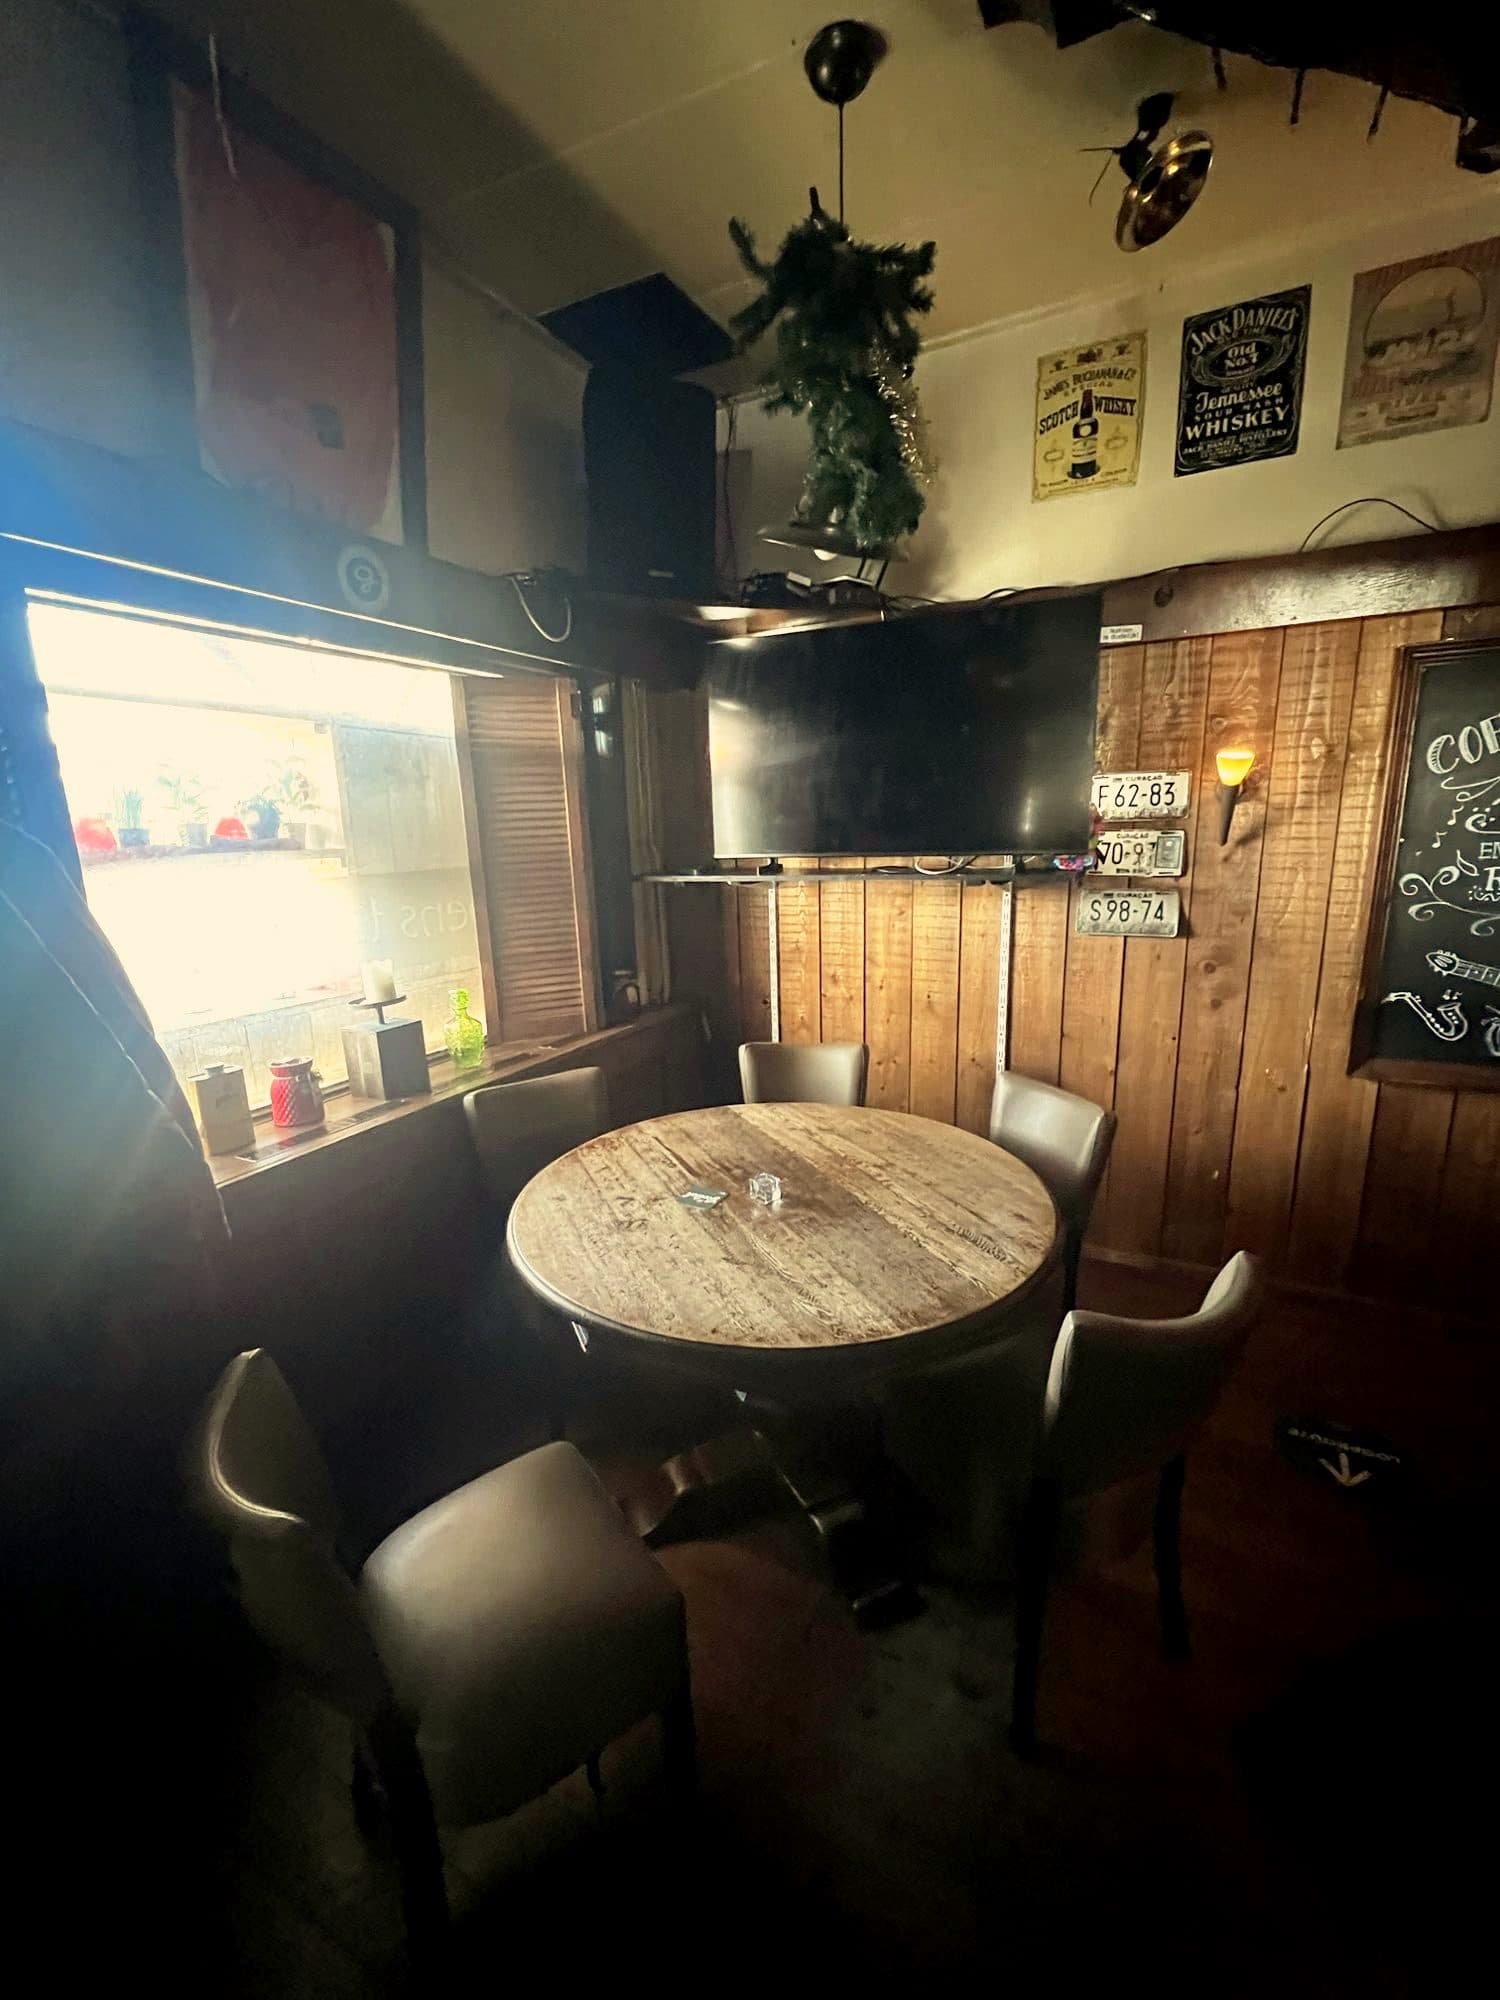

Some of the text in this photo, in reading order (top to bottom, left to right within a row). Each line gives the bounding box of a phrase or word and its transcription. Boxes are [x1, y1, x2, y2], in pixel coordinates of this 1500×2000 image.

[1192, 317, 1231, 355] JACK
[1228, 342, 1257, 358] Old
[1039, 396, 1137, 435] SCOTCH WHISKY
[1195, 383, 1282, 413] Tennessee
[1185, 404, 1289, 440] WHISKEY
